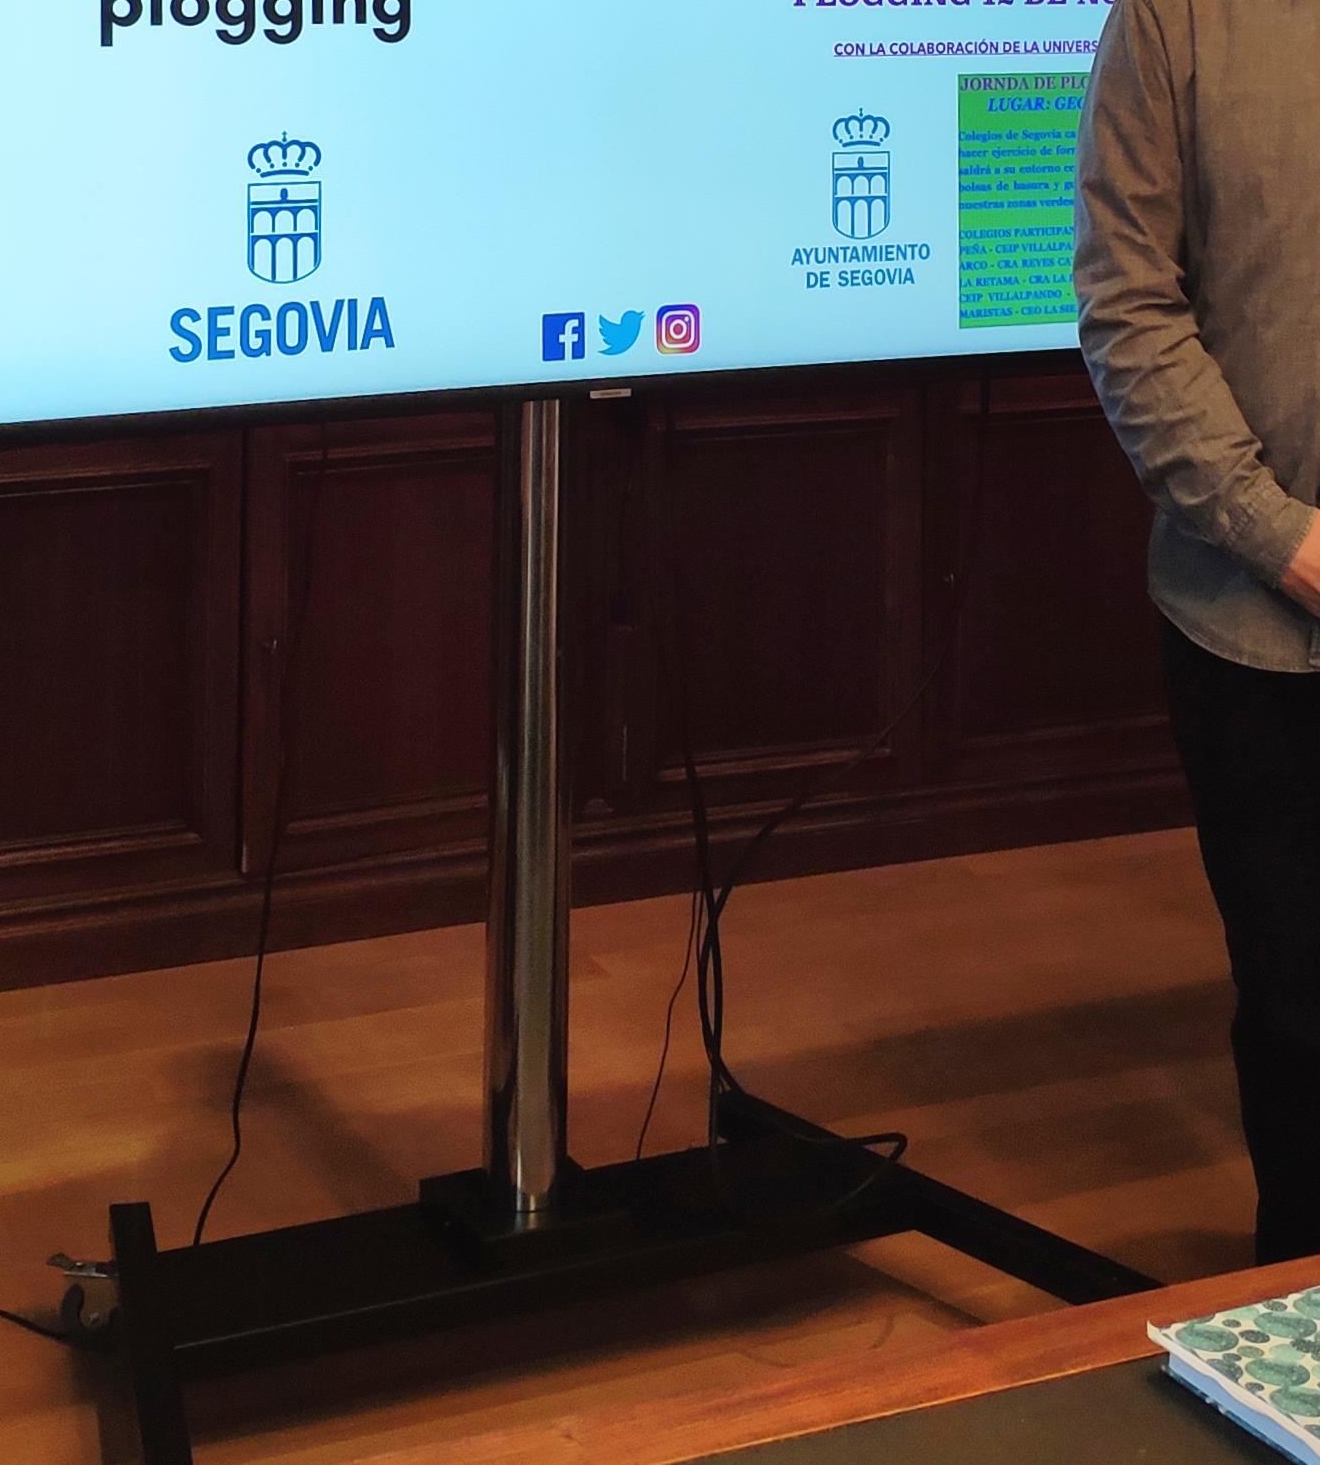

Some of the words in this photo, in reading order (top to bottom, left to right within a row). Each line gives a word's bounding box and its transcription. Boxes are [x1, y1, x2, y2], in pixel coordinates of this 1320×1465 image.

[834, 42, 865, 56] CON
[869, 42, 886, 56] LA
[889, 38, 999, 55] COLABORACIÓN
[1003, 41, 1021, 54] DE
[1023, 41, 1040, 54] LA
[960, 76, 1030, 92] JORNDA
[1034, 76, 1057, 90] DE
[987, 96, 1051, 113] LUGAR:
[791, 243, 931, 266] AYUNTAMIENTO
[1057, 257, 1074, 267] CA
[806, 270, 831, 289] DE
[837, 267, 916, 287] SEGOVIA
[168, 296, 396, 364] SEGOVIA
